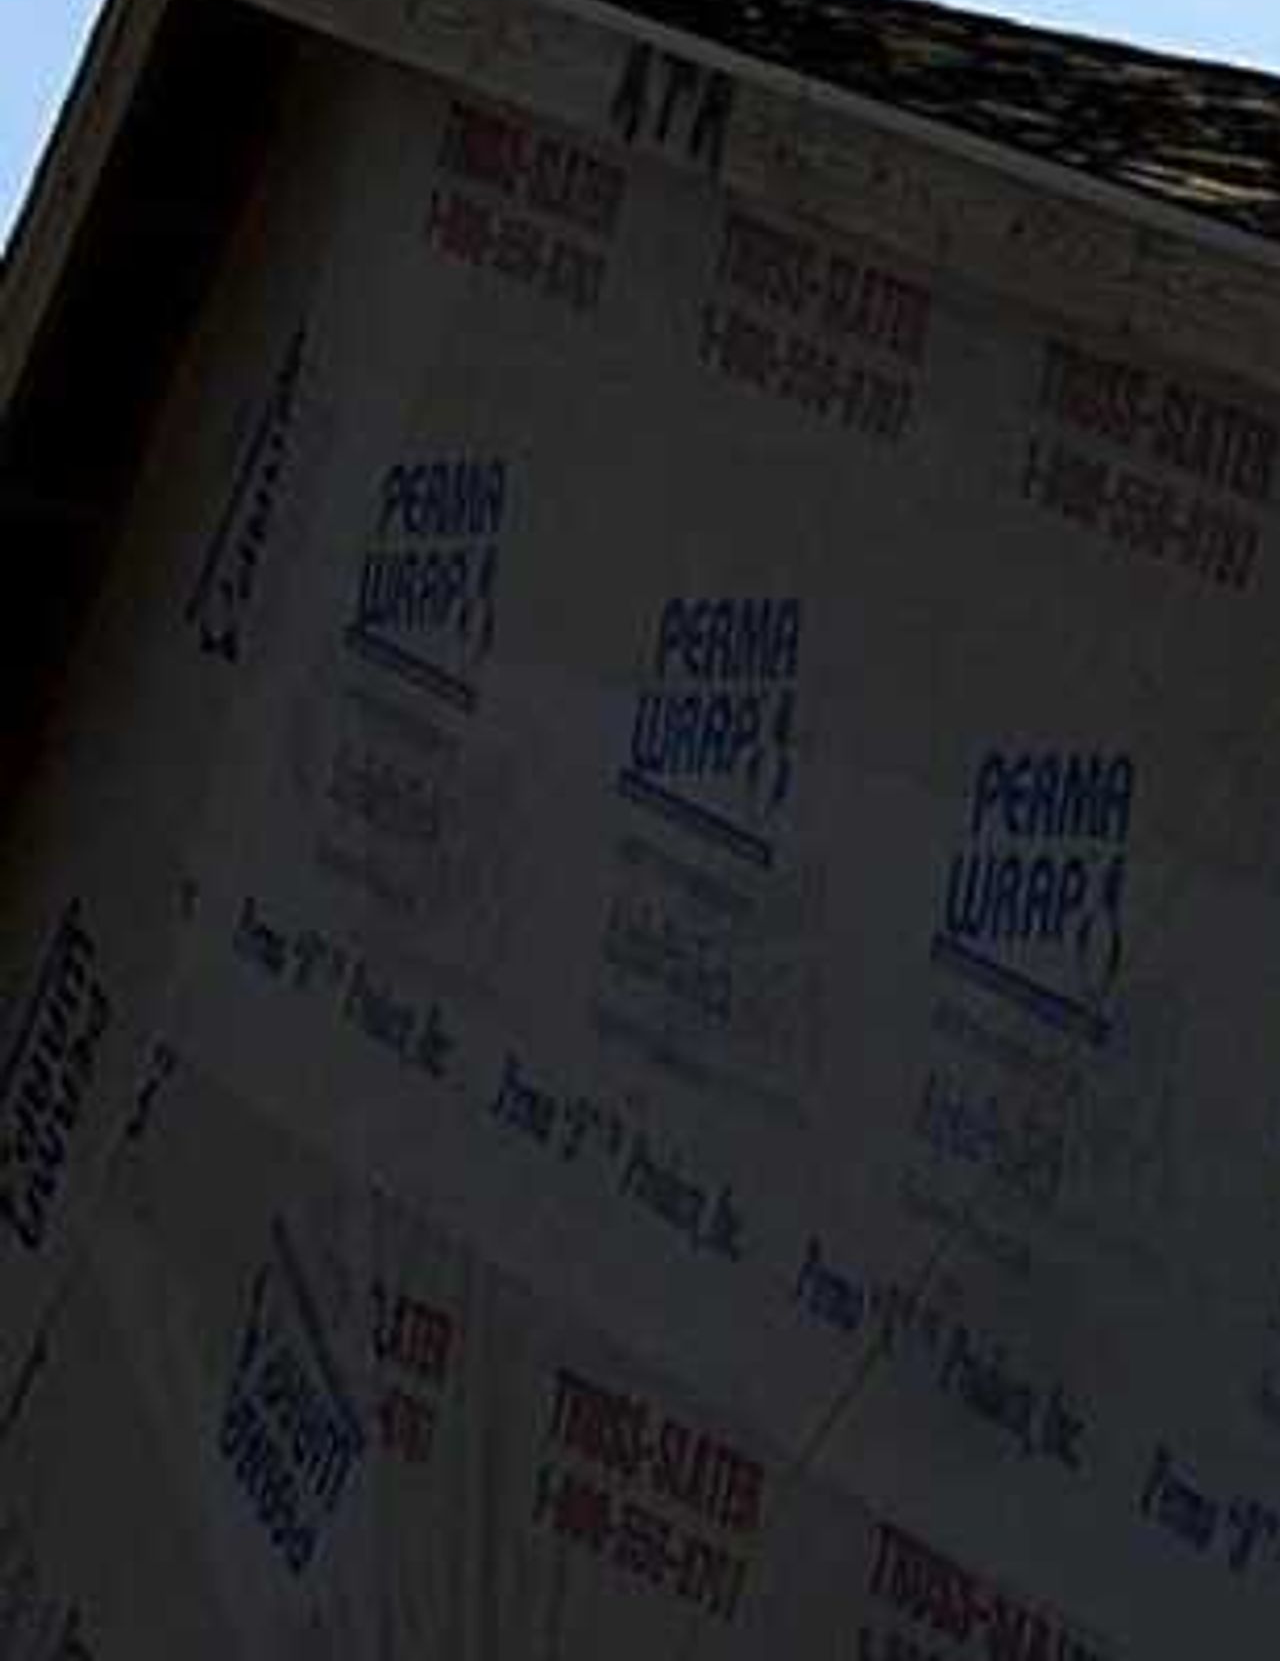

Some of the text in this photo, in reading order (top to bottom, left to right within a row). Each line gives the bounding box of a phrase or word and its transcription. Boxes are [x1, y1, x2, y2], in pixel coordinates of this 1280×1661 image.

[660, 597, 800, 680] PERMA
[630, 691, 762, 775] WRAP
[970, 752, 1134, 840] PERMA
[944, 854, 1090, 943] WRAP
